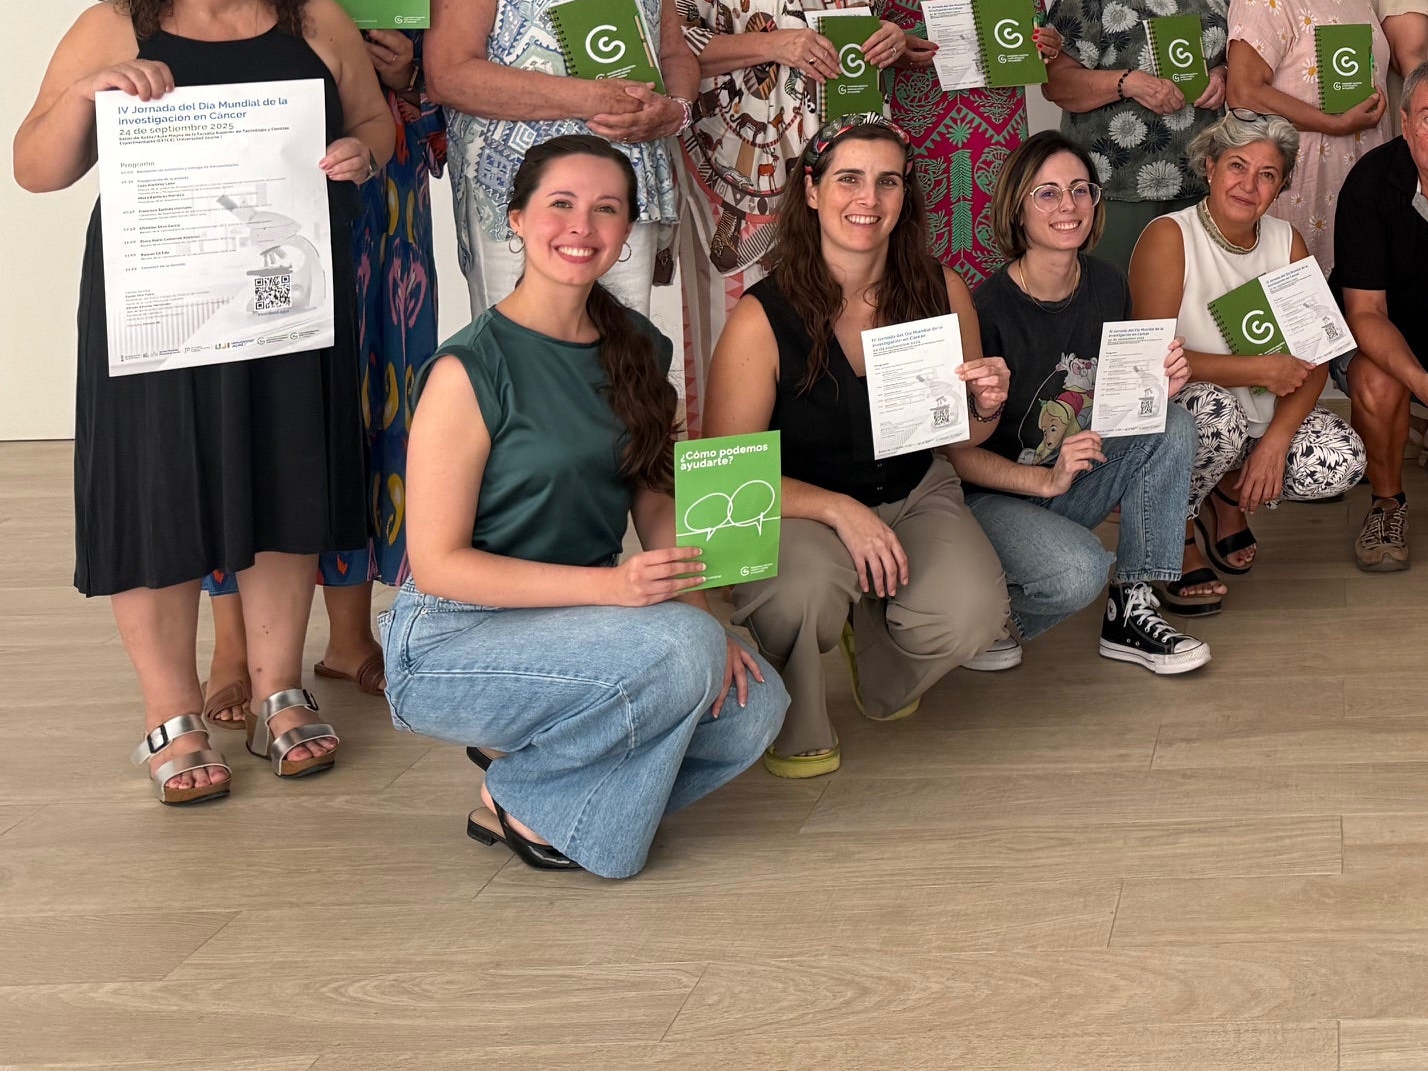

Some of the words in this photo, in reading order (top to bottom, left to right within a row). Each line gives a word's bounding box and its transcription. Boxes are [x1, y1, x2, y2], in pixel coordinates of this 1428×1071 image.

[118, 106, 129, 115] IV
[132, 104, 176, 114] Jornada
[178, 102, 195, 111] del
[218, 99, 260, 109] Mundial
[262, 98, 276, 106] de
[278, 97, 288, 105] la
[209, 111, 247, 120] Cáncer
[133, 127, 147, 135] de
[150, 123, 208, 135] septiembre
[680, 450, 716, 463] ¿Cómo
[720, 444, 768, 458] podemos
[680, 456, 733, 471] ayudarte?
